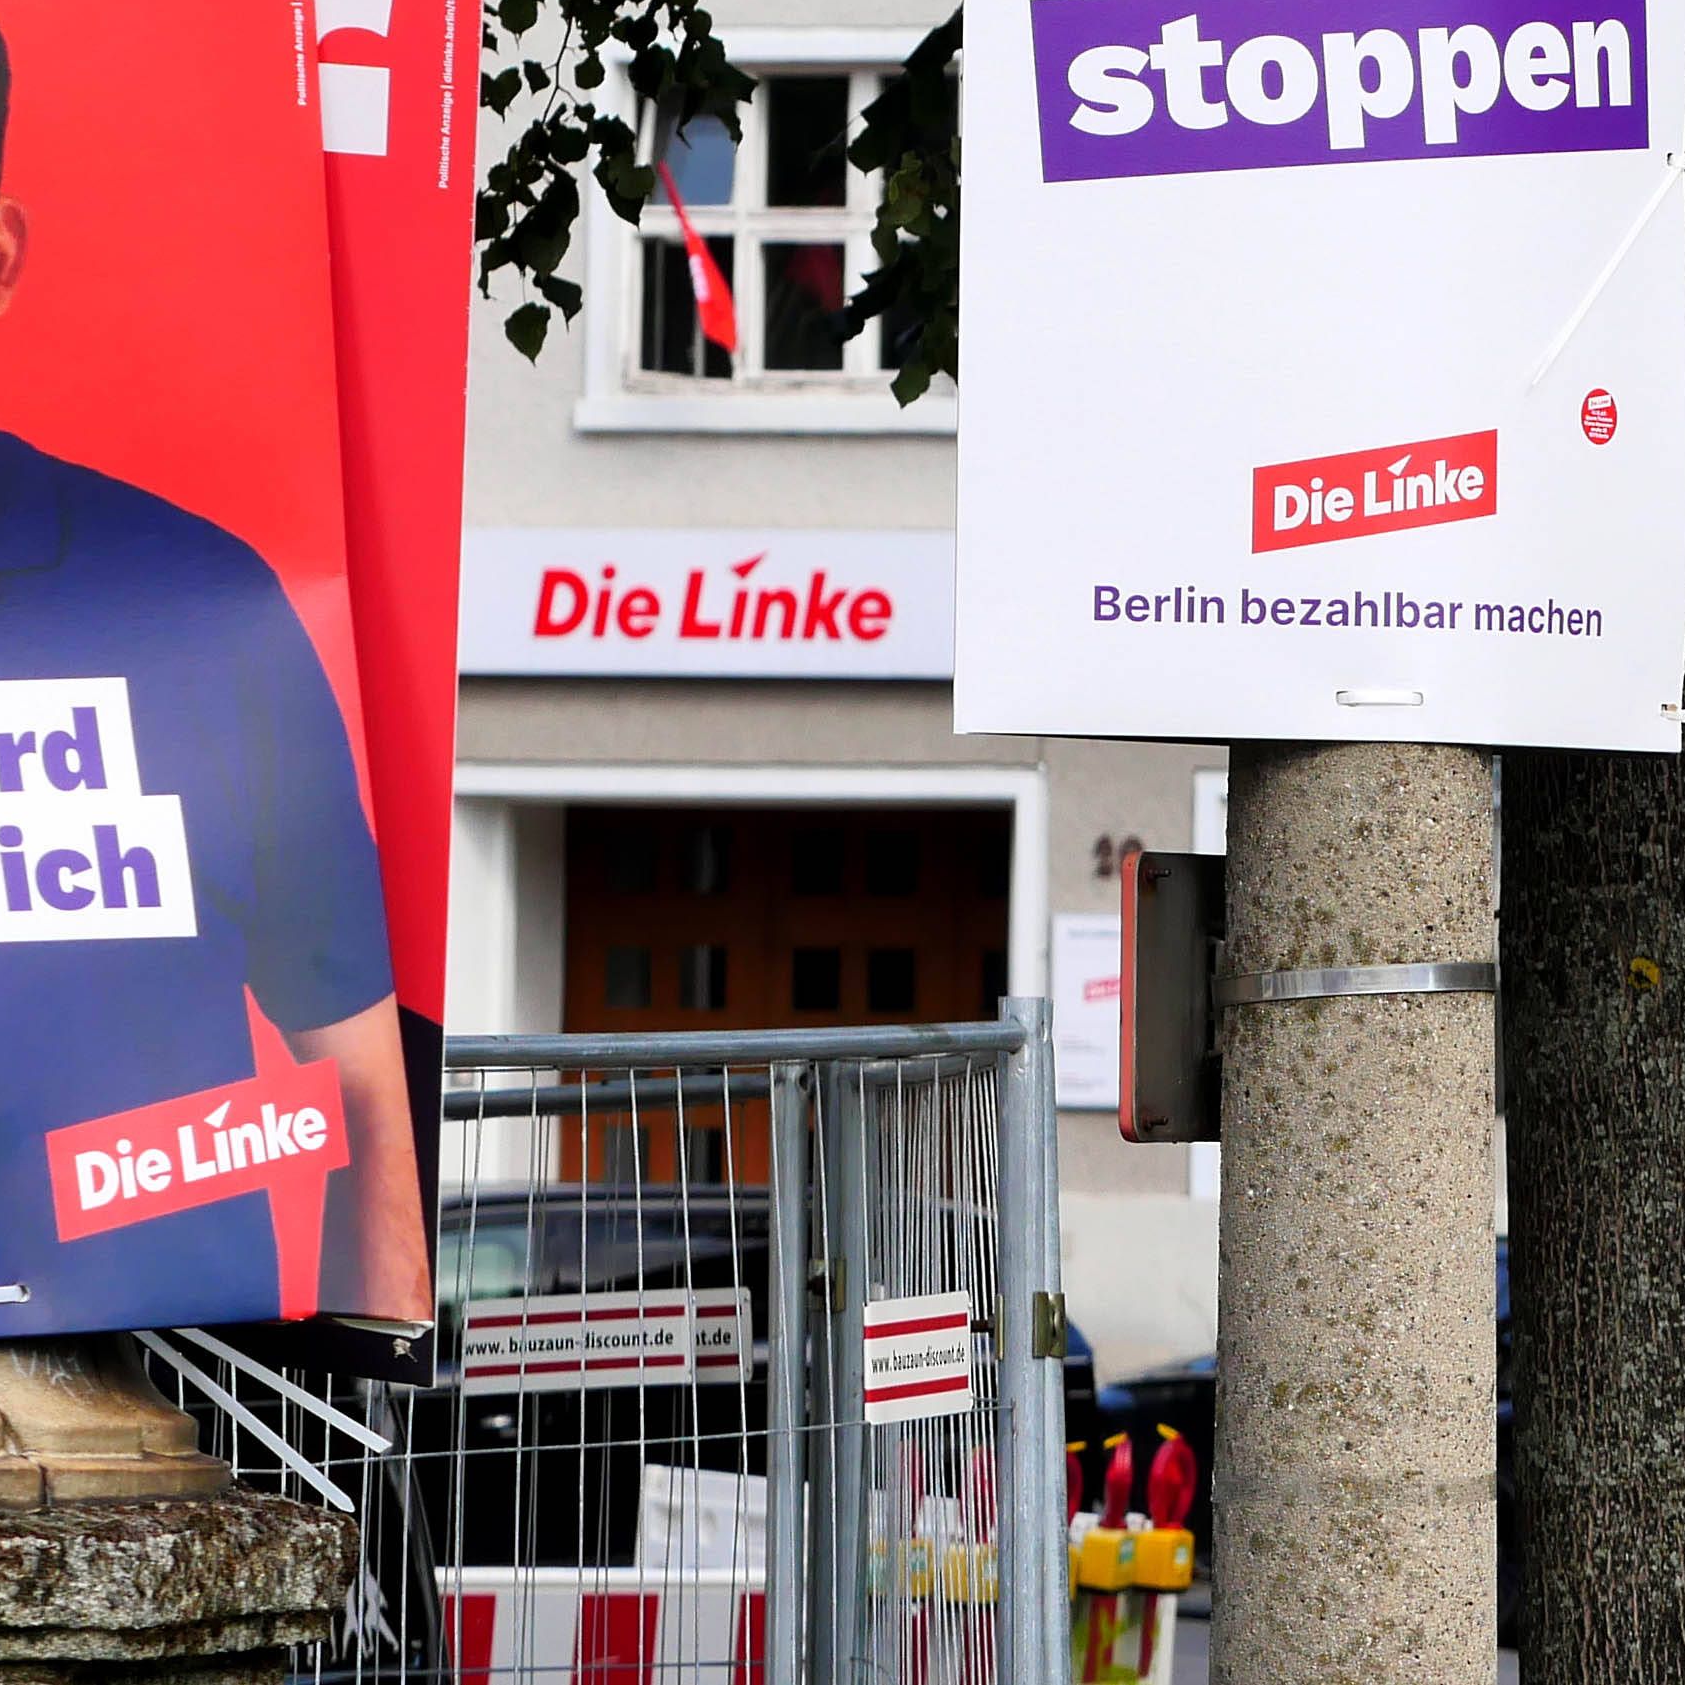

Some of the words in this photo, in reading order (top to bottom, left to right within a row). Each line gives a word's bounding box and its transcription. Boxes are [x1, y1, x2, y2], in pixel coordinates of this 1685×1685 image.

[292, 8, 306, 52] Anzeige
[296, 54, 308, 106] Politische
[1067, 13, 1631, 151] stoppen
[441, 90, 454, 136] Anzeige
[439, 138, 451, 189] Politische
[1273, 477, 1353, 533] Die
[1363, 454, 1485, 517] Linke
[533, 565, 660, 638] Die
[679, 551, 893, 641] Linke
[1092, 584, 1226, 625] Berlin
[1240, 587, 1463, 630] bezahlbar
[1473, 597, 1603, 638] machen
[74, 1143, 171, 1212] Die
[177, 1099, 329, 1186] Linke
